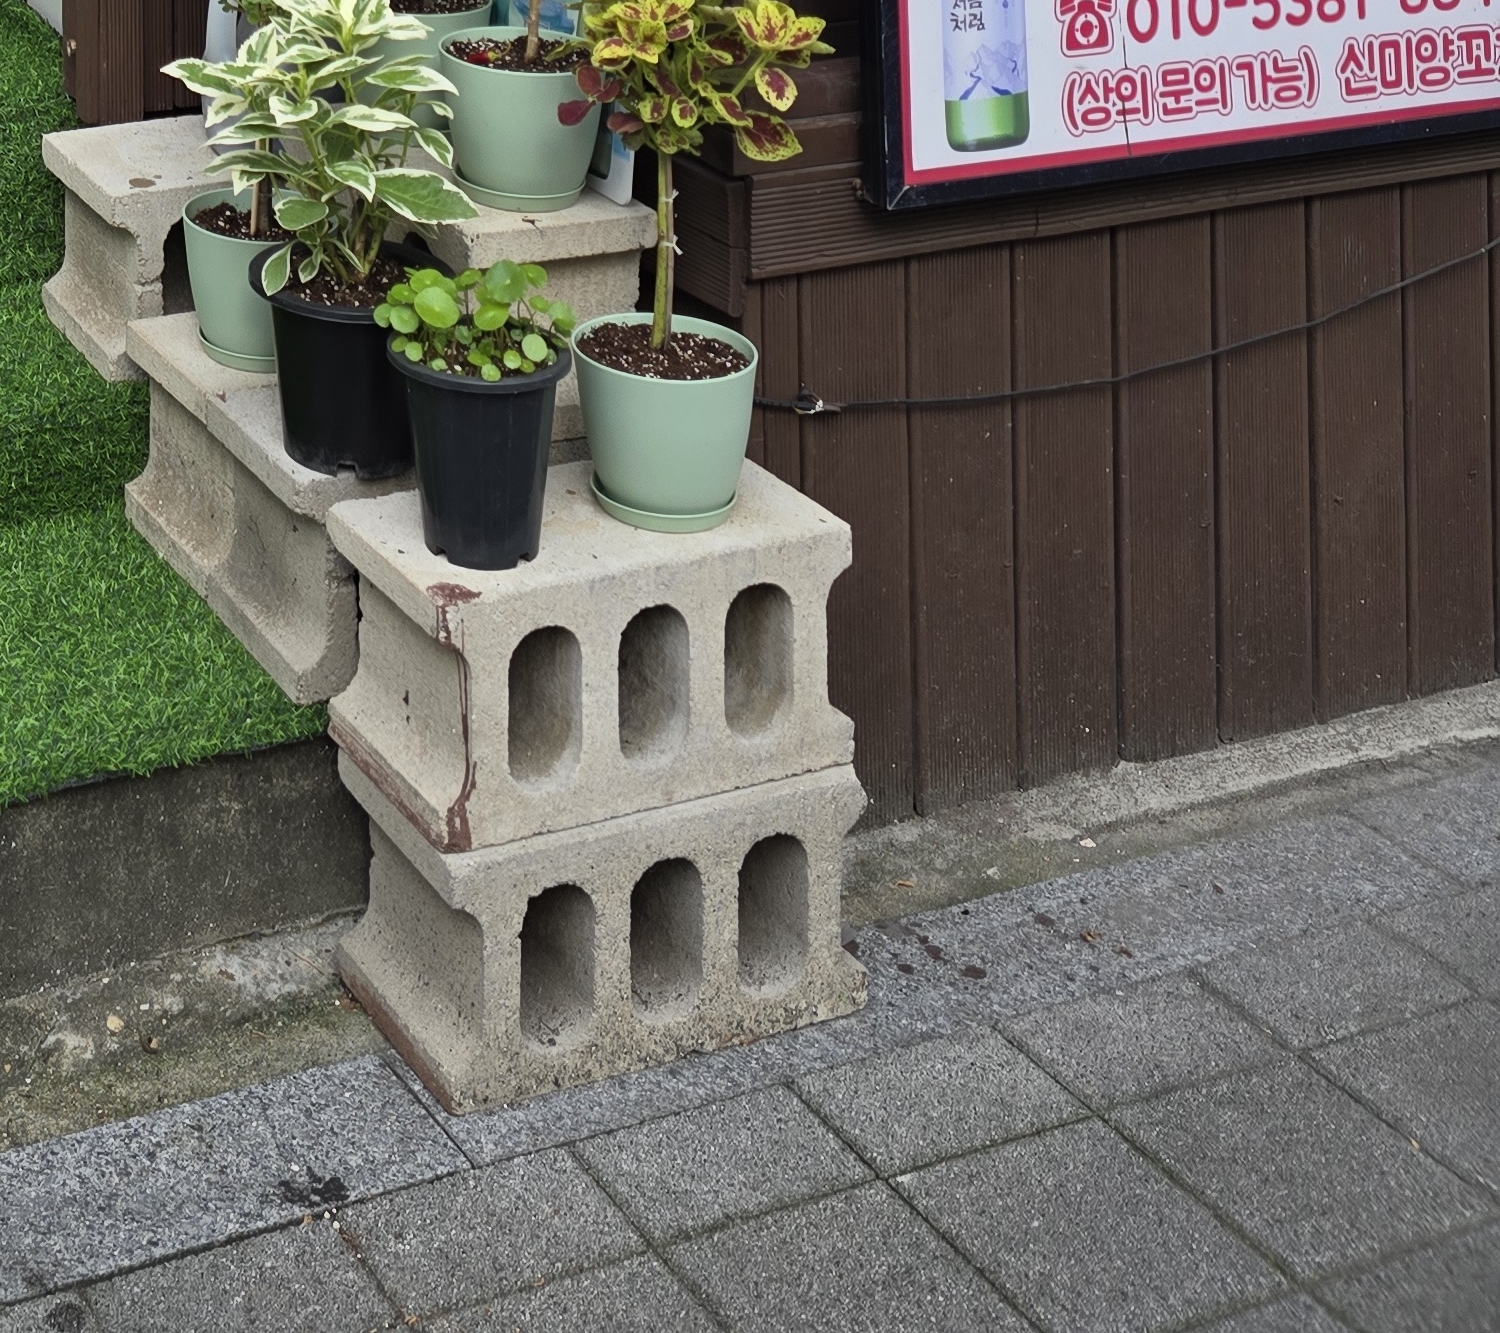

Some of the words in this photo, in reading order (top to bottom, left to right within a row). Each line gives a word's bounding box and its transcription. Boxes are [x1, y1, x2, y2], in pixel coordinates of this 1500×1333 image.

[949, 10, 986, 33] 처럼
[1158, 61, 1228, 118] 문의
[1236, 50, 1315, 107] 가능)
[1339, 29, 1500, 97] 신미양꼬
